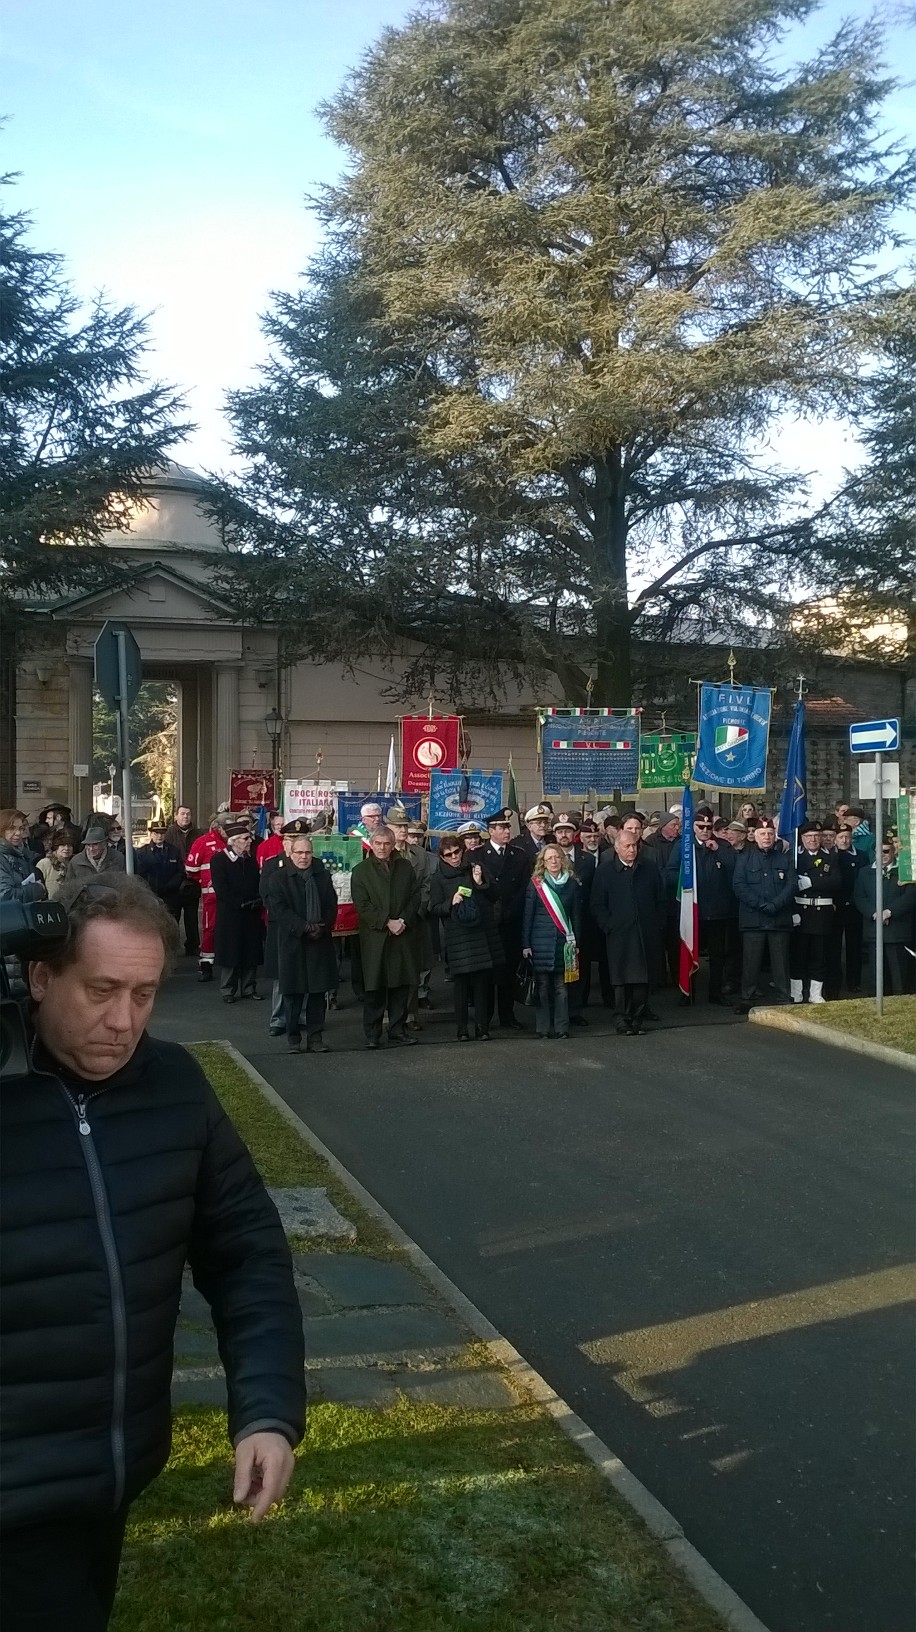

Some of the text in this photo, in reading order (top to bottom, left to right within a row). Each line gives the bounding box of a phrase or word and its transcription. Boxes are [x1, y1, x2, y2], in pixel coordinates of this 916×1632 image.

[699, 762, 726, 783] SEZIONE
[737, 767, 762, 784] TORINO
[641, 775, 666, 784] SEZIONE
[289, 789, 316, 798] CROCE
[36, 913, 61, 925] RAI
